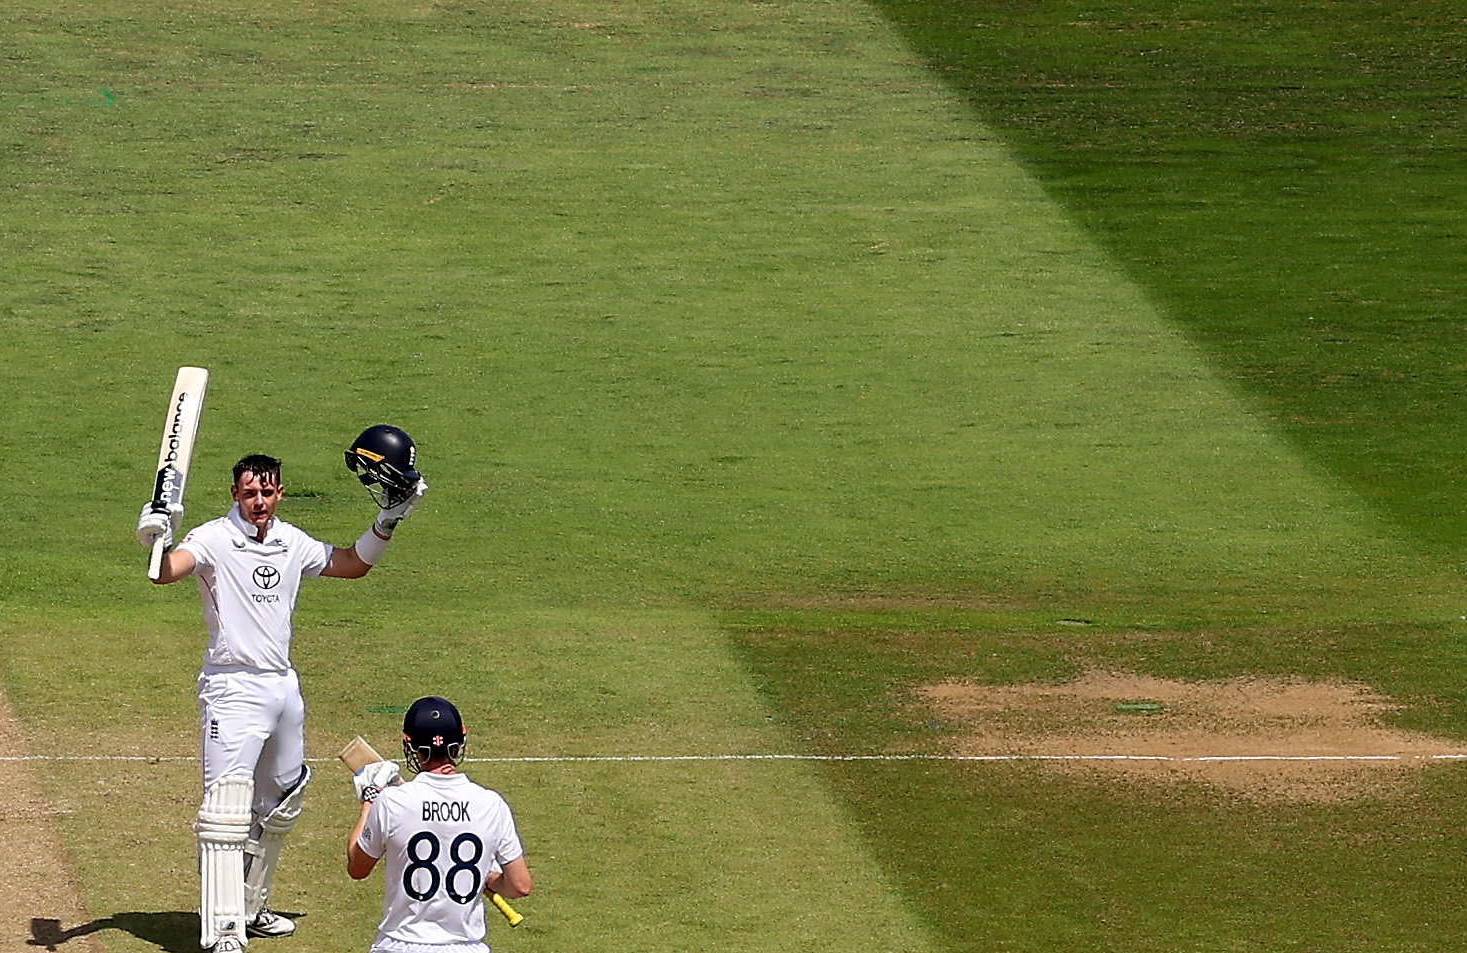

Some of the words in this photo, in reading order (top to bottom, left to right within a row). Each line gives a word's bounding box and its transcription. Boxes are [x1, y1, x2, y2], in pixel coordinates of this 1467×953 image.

[164, 392, 188, 462] balance
[160, 467, 176, 502] new
[251, 594, 280, 603] TOYOTA
[421, 800, 471, 822] BROOK
[403, 831, 484, 905] 88
